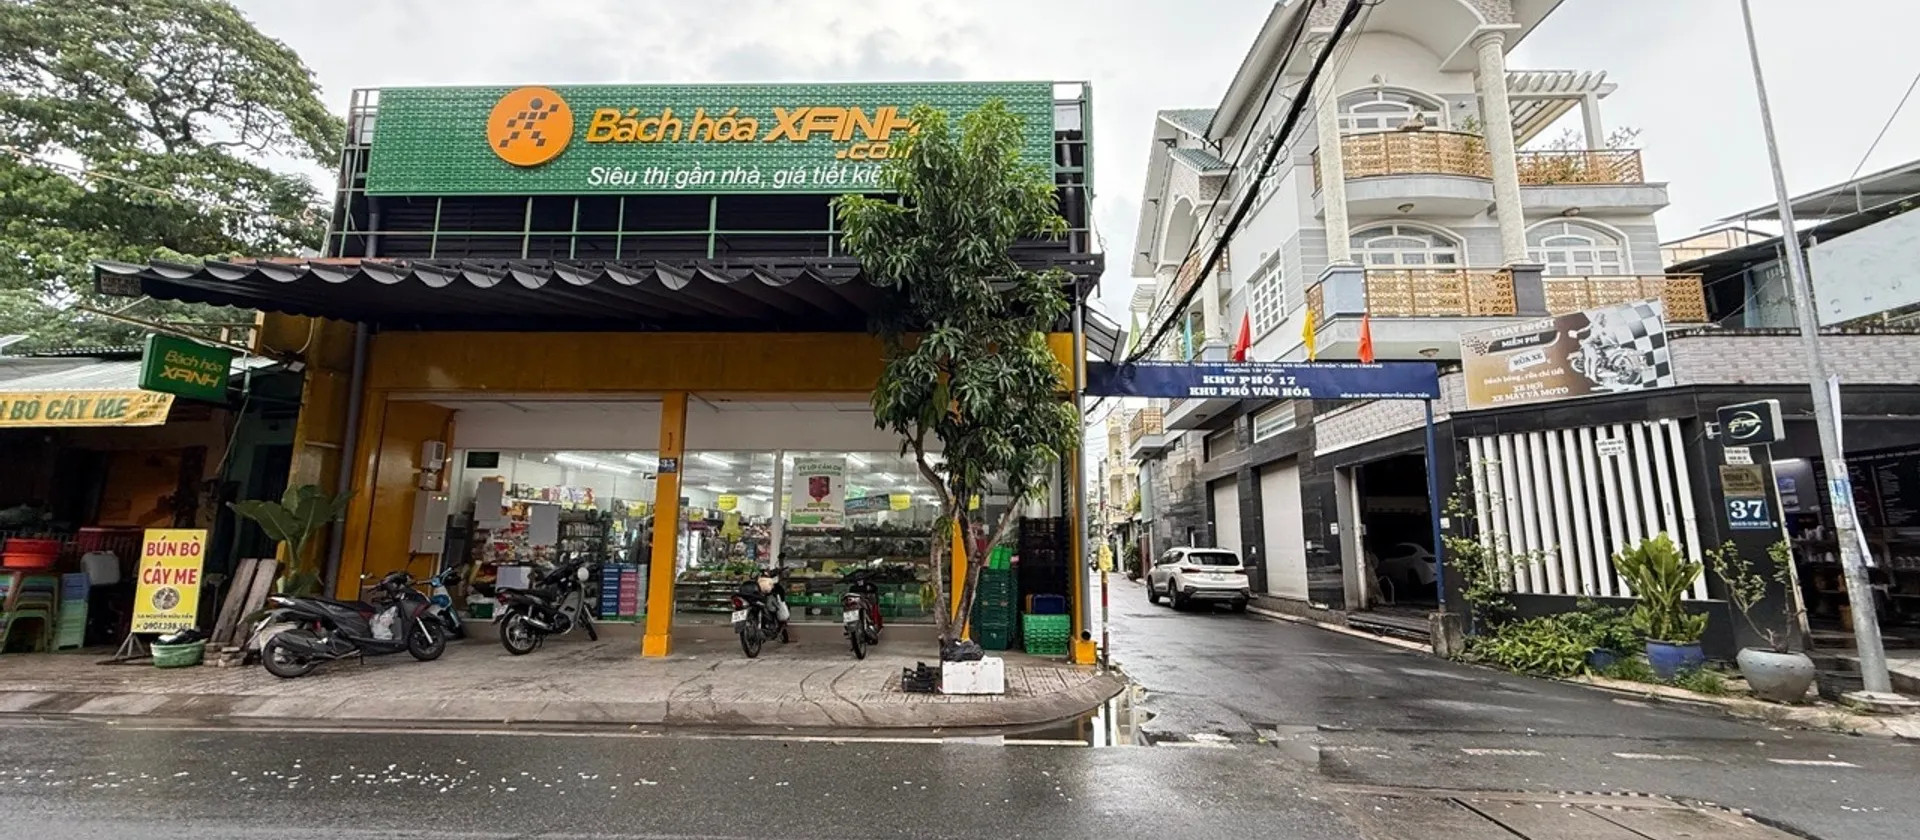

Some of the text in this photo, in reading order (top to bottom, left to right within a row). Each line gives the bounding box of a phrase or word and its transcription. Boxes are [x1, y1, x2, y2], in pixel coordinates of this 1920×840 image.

[586, 106, 921, 143] Bách hóa XANH
[587, 166, 637, 185] Siêu
[643, 167, 671, 189] thị
[674, 161, 719, 189] gần
[720, 165, 768, 188] nhà,
[773, 166, 807, 188] giá
[813, 160, 846, 185] tiết
[1491, 324, 1520, 338] THAY
[164, 350, 224, 373] Bách hóa
[160, 364, 221, 388] XANH
[1203, 373, 1296, 385] KHU PHỐ 17
[142, 392, 167, 404] 31A
[1189, 387, 1218, 396] KHU
[1221, 383, 1250, 396] PHỐ
[1282, 385, 1312, 397] HÓA
[1513, 385, 1526, 393] XE
[1541, 386, 1569, 396] MOTO
[10, 395, 40, 420] BÒ
[46, 394, 89, 420] CÂY
[93, 398, 130, 419] ME
[1730, 500, 1763, 518] 37
[146, 535, 200, 556] BÚN BÒ
[143, 560, 198, 585] CÂY ME
